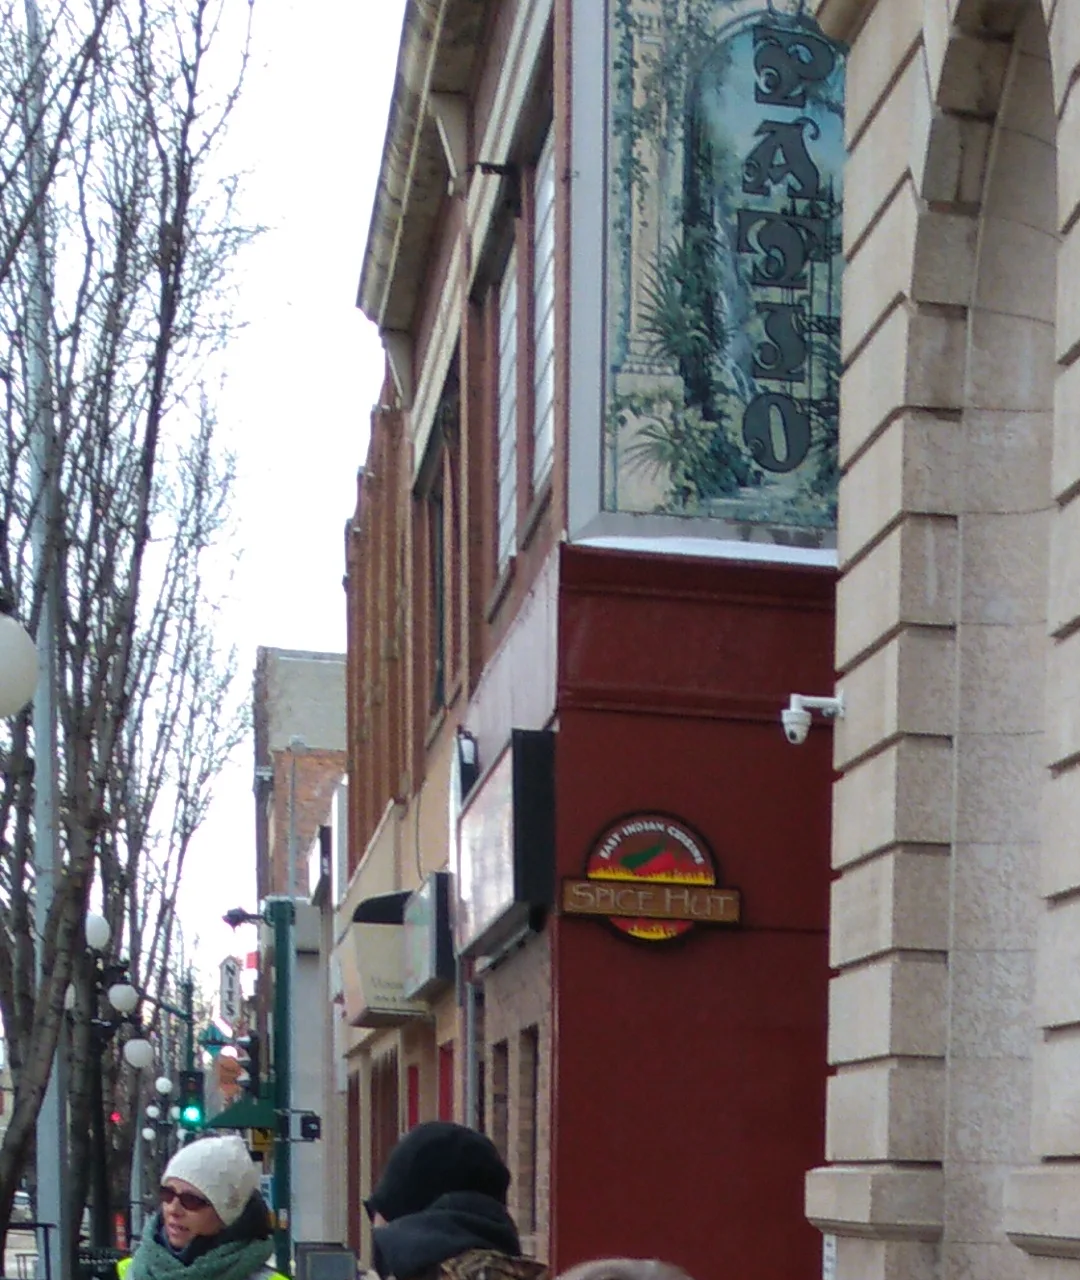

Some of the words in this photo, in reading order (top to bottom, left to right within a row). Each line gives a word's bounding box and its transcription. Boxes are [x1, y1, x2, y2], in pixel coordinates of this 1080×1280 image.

[737, 26, 836, 473] PATIO
[621, 820, 665, 836] INDIAN
[569, 882, 653, 910] SPICE
[664, 887, 734, 916] HUT
